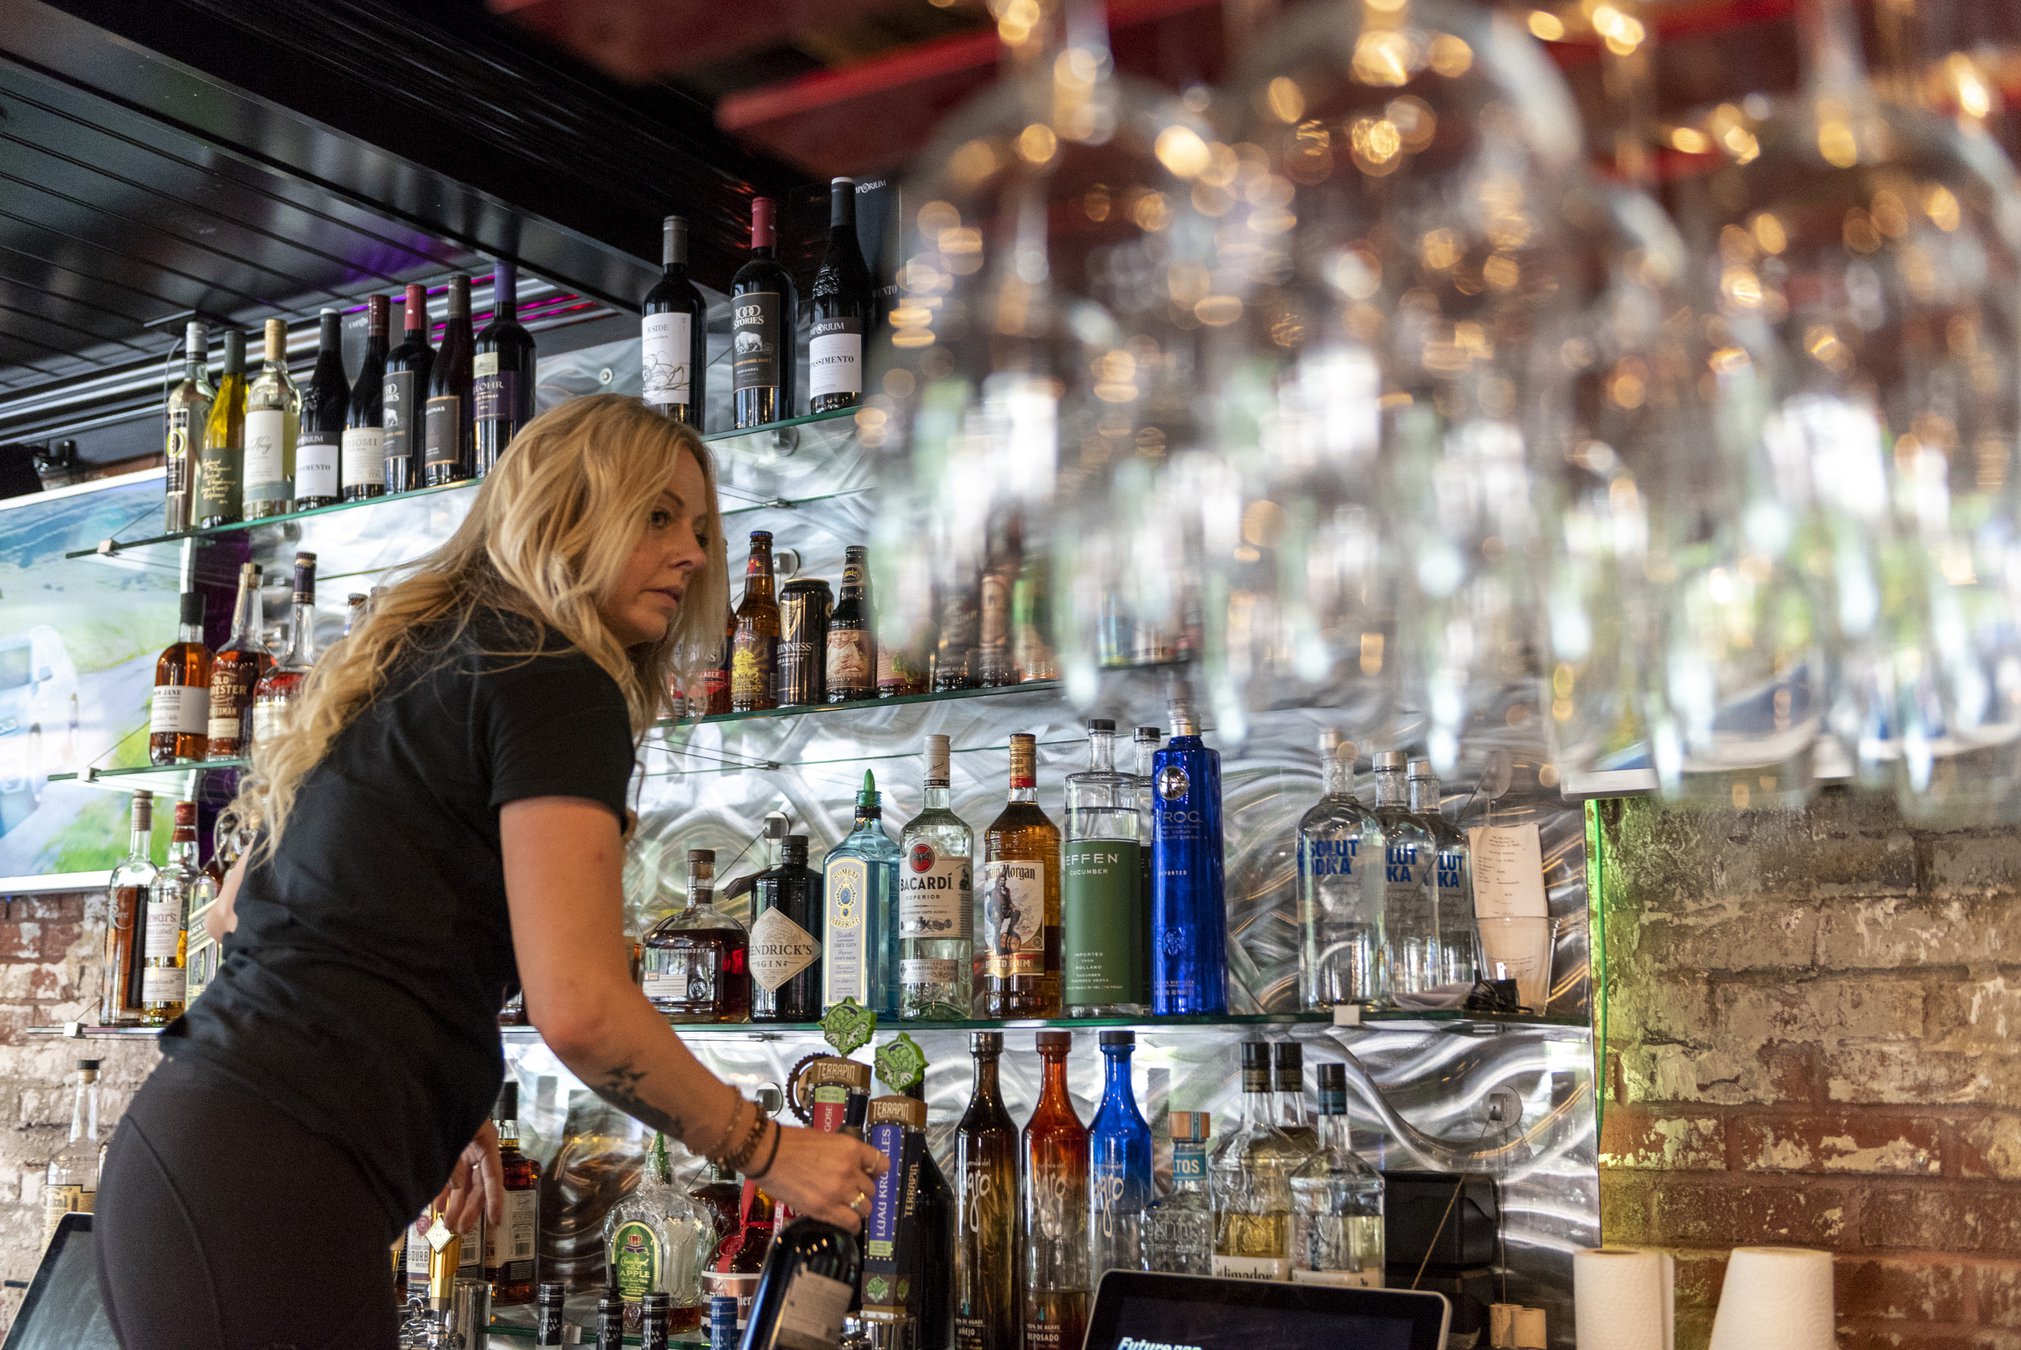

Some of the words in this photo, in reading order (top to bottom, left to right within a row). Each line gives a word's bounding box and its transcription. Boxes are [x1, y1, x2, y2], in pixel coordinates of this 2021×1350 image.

[735, 304, 761, 320] 1000
[734, 315, 764, 330] STORIES
[213, 675, 229, 685] OLD
[1065, 853, 1118, 866] EFFEN
[1001, 865, 1036, 880] Morgan
[1069, 868, 1108, 876] CUCUMBER
[900, 873, 953, 892] BACARDÍ
[750, 944, 813, 957] ENDRICK'S
[817, 1062, 855, 1081] TERRAPIN
[872, 1101, 910, 1120] TERRAPIN
[823, 1105, 833, 1132] GOSE
[904, 1160, 919, 1218] TERRAPIN
[876, 1201, 886, 1237] LUAU
[619, 1270, 651, 1278] APPLE
